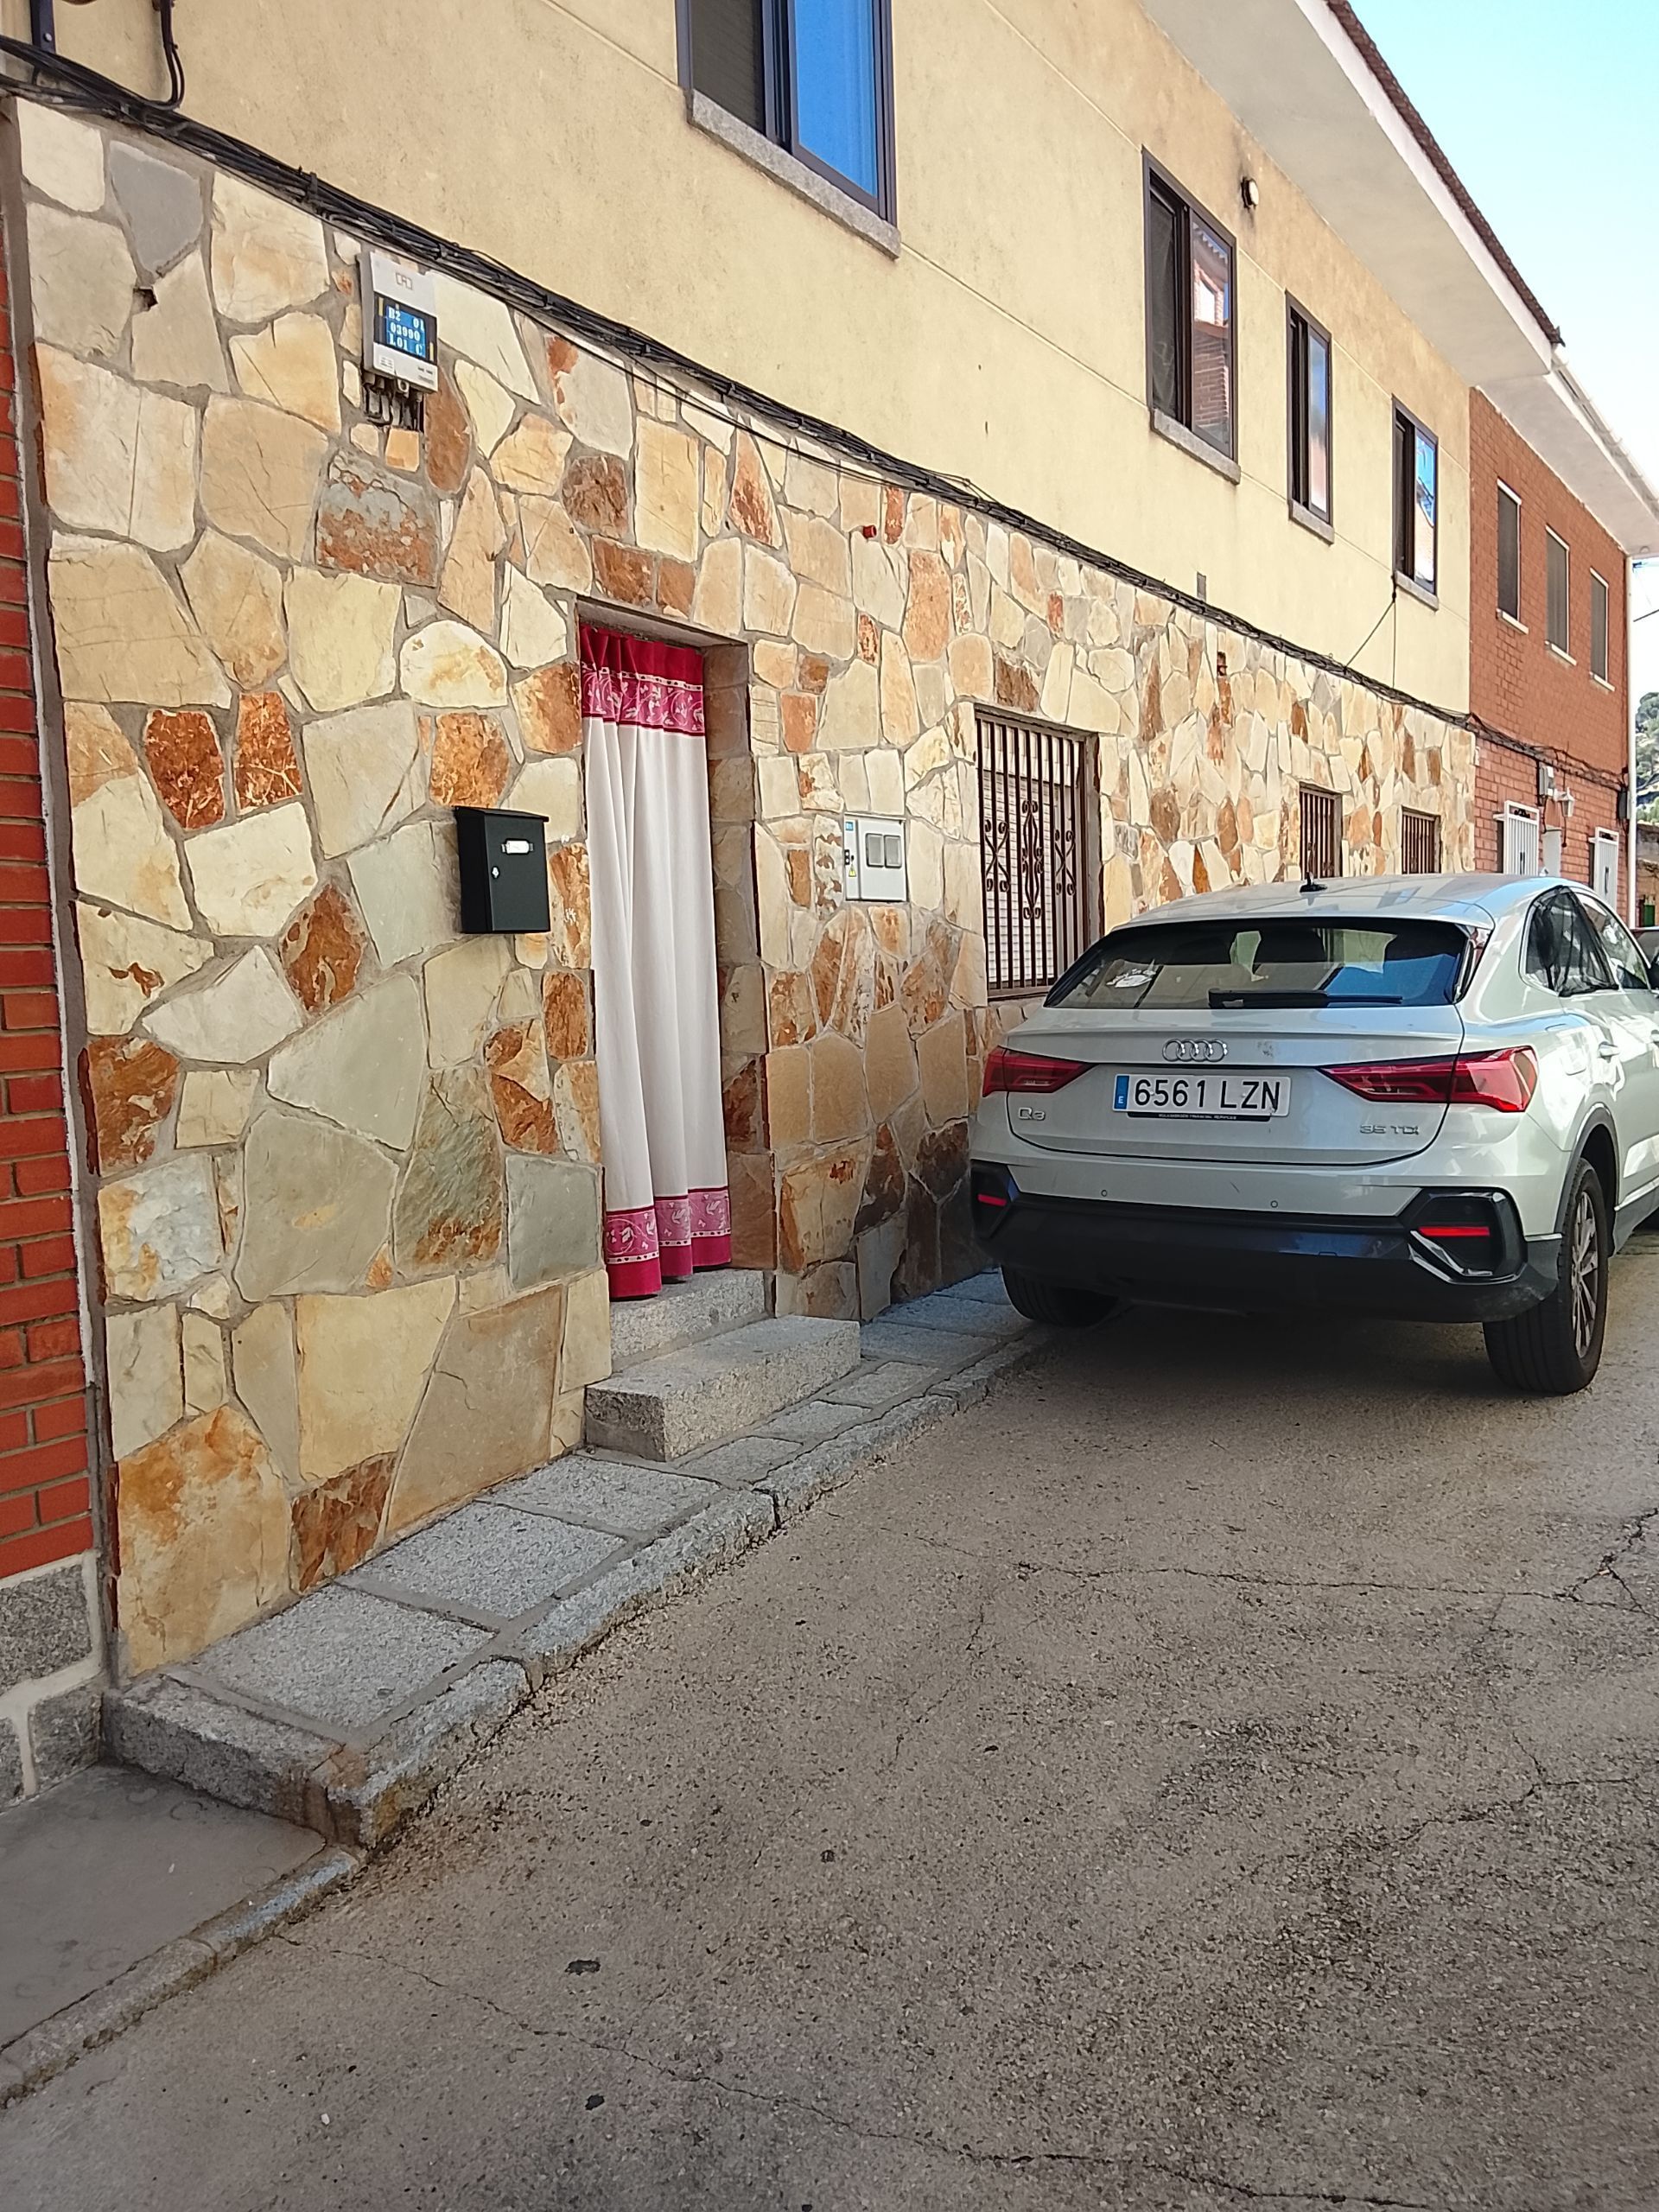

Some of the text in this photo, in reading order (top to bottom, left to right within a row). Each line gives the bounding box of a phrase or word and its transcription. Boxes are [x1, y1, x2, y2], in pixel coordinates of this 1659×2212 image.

[1117, 1096, 1124, 1104] E
[1135, 1079, 1281, 1112] 6561 LZN
[1019, 1107, 1046, 1121] Q3
[1360, 1124, 1420, 1135] 35 TDI
